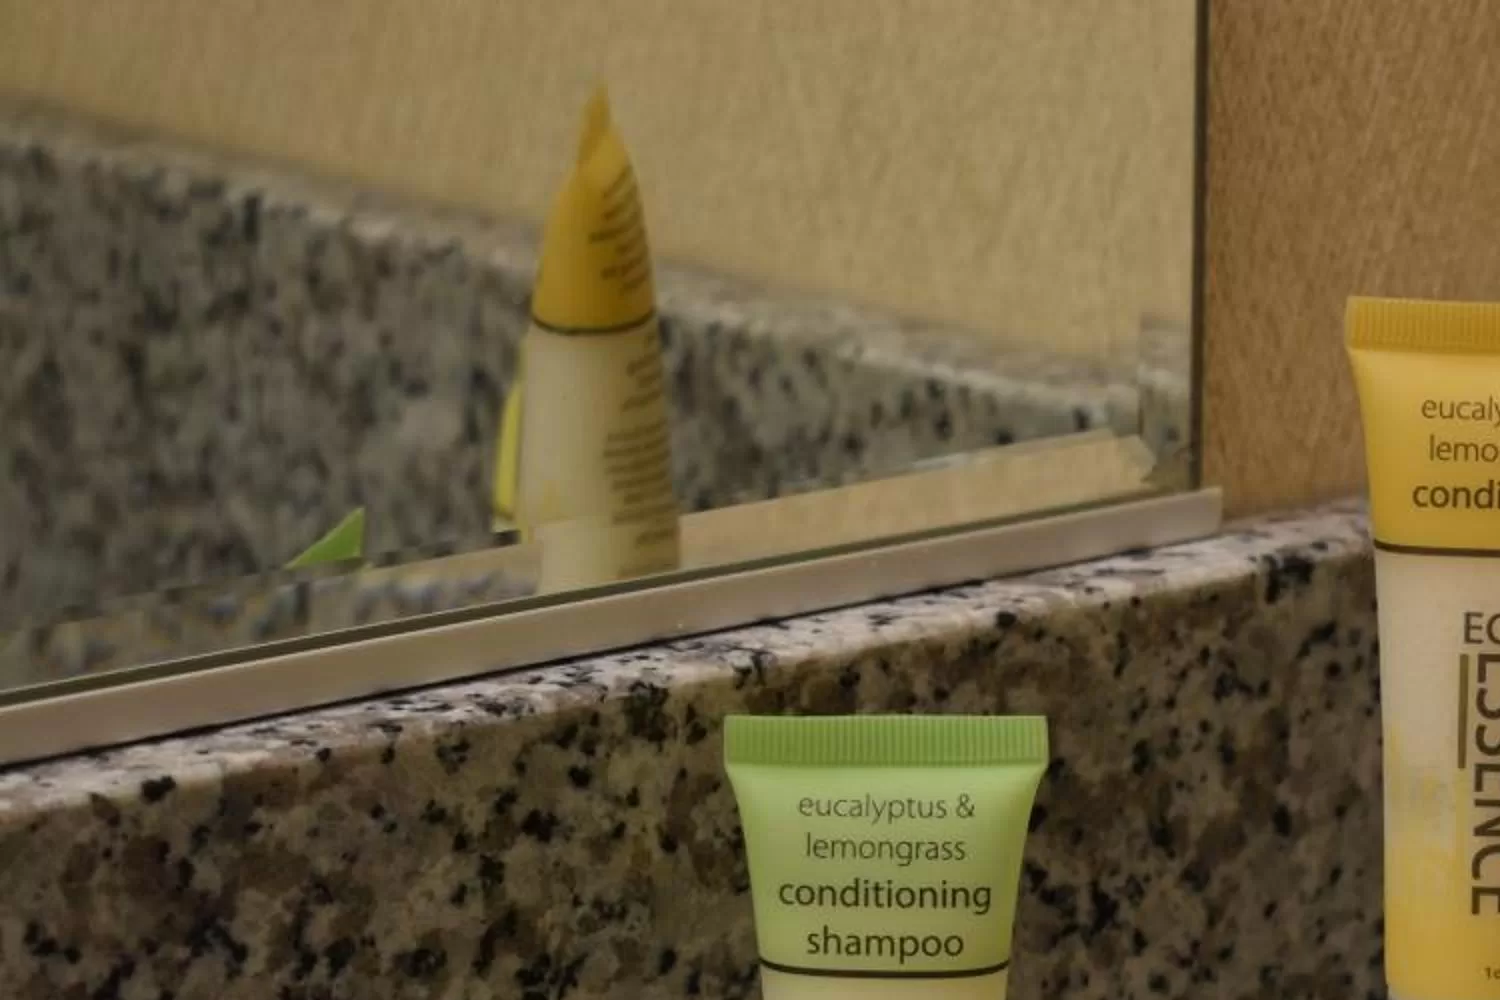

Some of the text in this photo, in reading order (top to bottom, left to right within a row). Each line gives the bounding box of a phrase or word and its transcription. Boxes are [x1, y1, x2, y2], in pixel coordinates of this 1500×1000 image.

[798, 793, 976, 825] eucalyptus &
[806, 832, 966, 866] lemongrass
[778, 878, 992, 915] conditioning
[806, 926, 964, 964] shampoo
